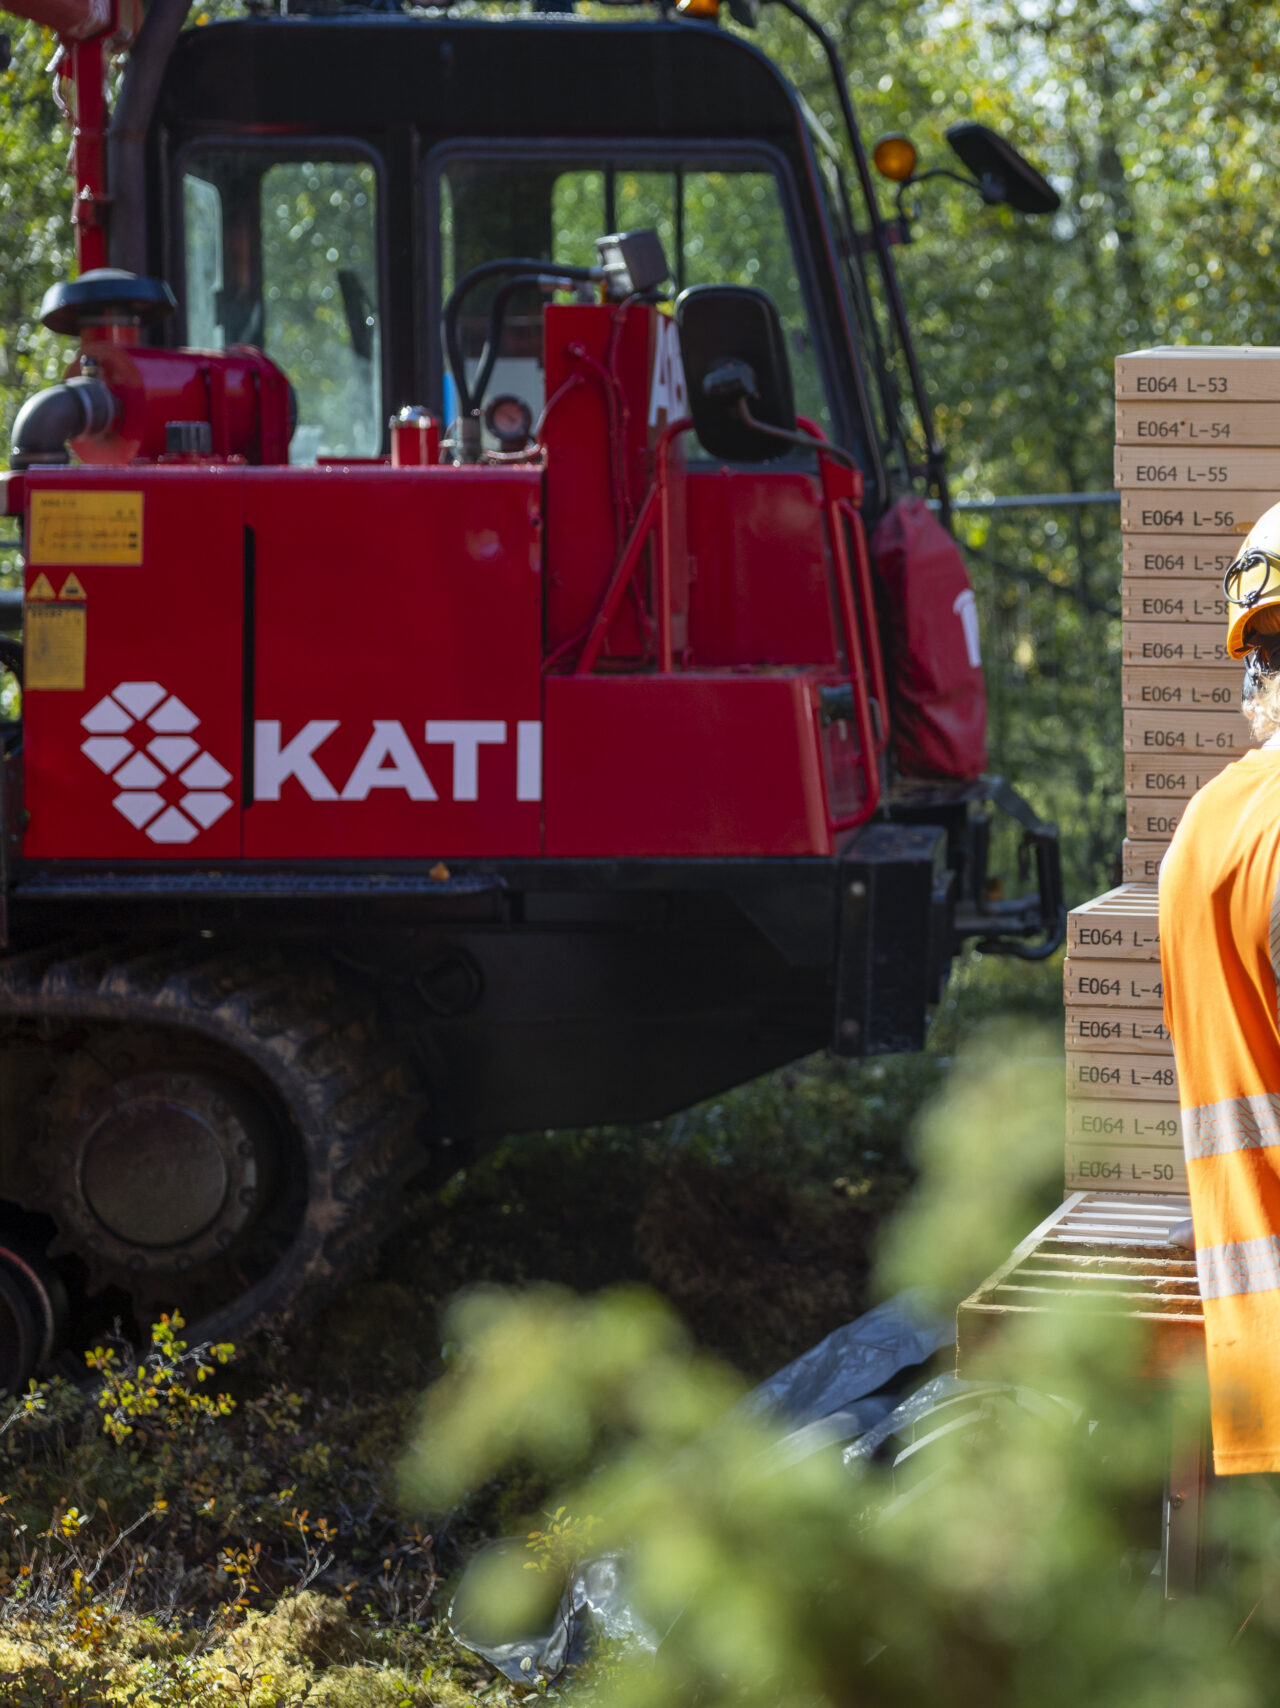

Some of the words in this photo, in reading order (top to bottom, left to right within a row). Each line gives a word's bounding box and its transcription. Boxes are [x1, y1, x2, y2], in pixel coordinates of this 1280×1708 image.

[1137, 377, 1177, 393] E064
[1187, 377, 1228, 393] L-53
[1138, 421, 1179, 437] E064
[1189, 423, 1230, 438] L-54
[1136, 466, 1177, 481] E064
[1187, 466, 1228, 482] L-55
[1142, 510, 1184, 526] E064
[1193, 511, 1234, 527] L-56
[1144, 554, 1184, 570] E064
[1143, 599, 1184, 614] E064
[1142, 643, 1184, 659] E064
[1141, 686, 1182, 702] E064
[1191, 687, 1231, 703] L-60
[1144, 730, 1185, 746] E064
[1195, 732, 1235, 748] L-61
[253, 720, 542, 801] KATI
[1146, 773, 1186, 789] E064
[1147, 817, 1178, 833] E06
[1079, 928, 1123, 946] E064
[1079, 977, 1121, 995] E064
[1079, 1021, 1122, 1039] E064
[1080, 1066, 1121, 1084] E064
[1131, 1069, 1174, 1086] L-48
[1082, 1116, 1124, 1134] E064
[1135, 1119, 1178, 1137] L-49
[1079, 1160, 1122, 1179] E064
[1132, 1163, 1174, 1181] L-50
